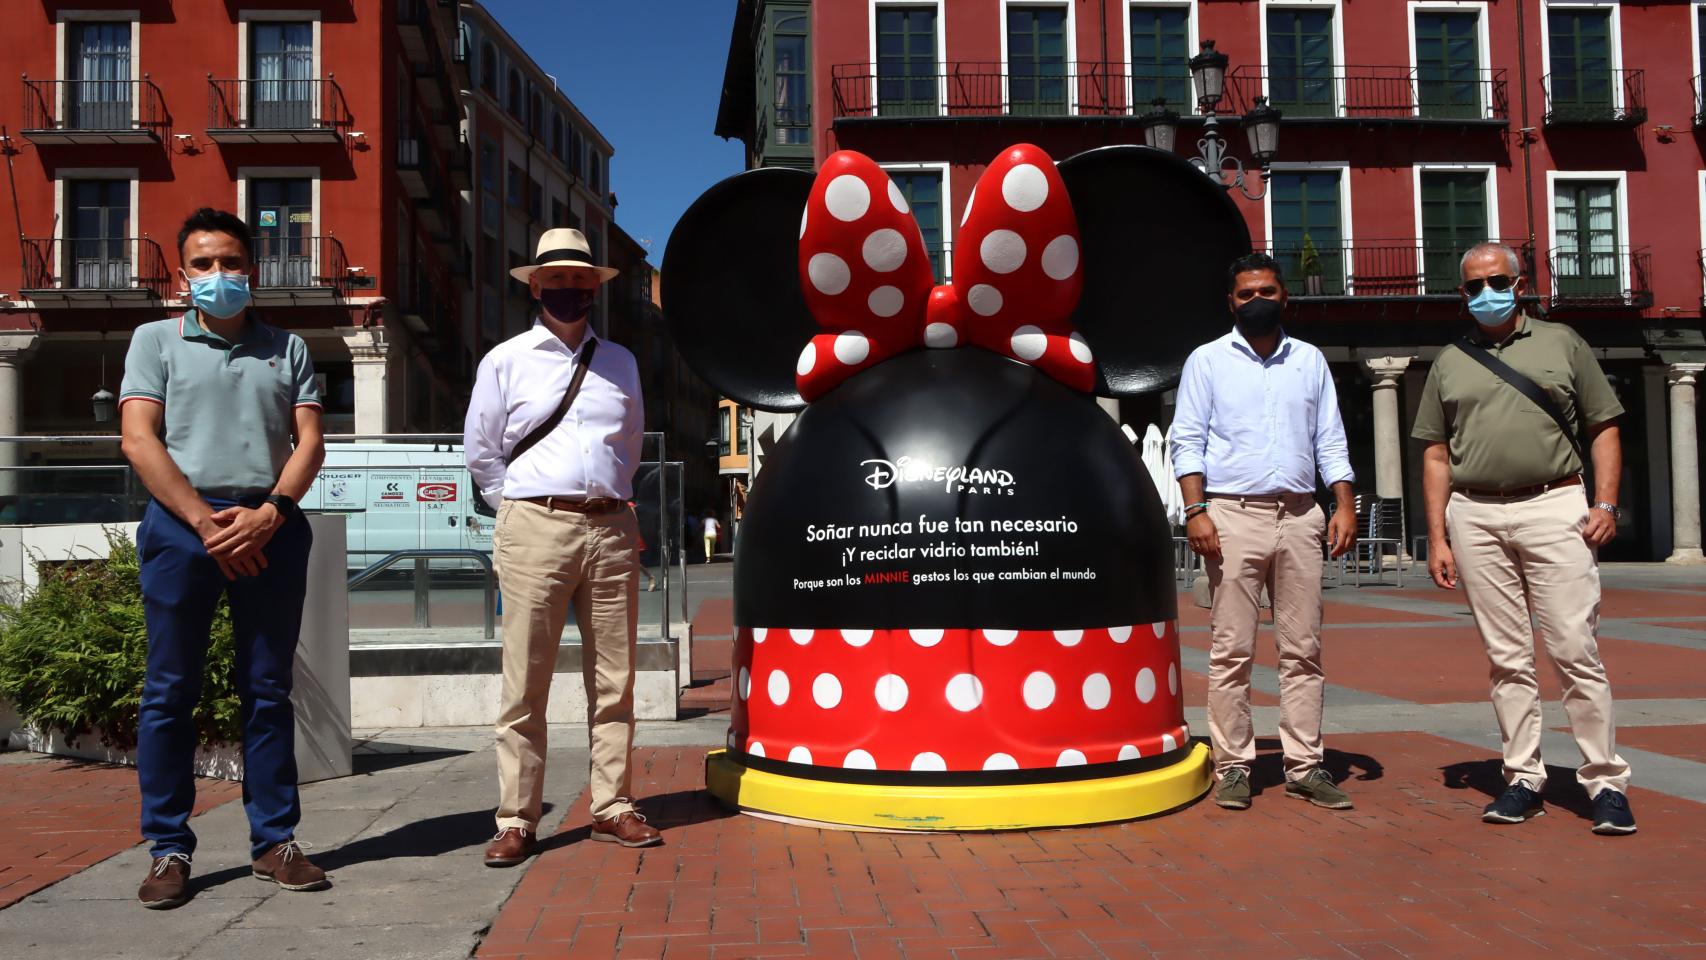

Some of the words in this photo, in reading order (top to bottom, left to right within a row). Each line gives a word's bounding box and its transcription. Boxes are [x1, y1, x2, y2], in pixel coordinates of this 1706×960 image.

[957, 485, 1015, 496] PARIS
[806, 523, 855, 542] Soñar
[859, 522, 912, 538] nunca
[919, 514, 949, 534] fue
[955, 516, 984, 533] tan
[990, 515, 1078, 533] necesario
[842, 547, 857, 567] ¡Y
[860, 542, 916, 562] reciclar
[920, 541, 966, 558] vidrio
[970, 539, 1039, 557] también!
[793, 578, 824, 591] Porque
[826, 577, 844, 587] son
[846, 574, 861, 586] los
[864, 570, 910, 584] MINNIE
[912, 571, 950, 585] gestos
[953, 568, 969, 581] los
[972, 572, 995, 583] que
[998, 567, 1047, 580] cambian
[1050, 567, 1060, 580] el
[1062, 567, 1097, 580] mundo
